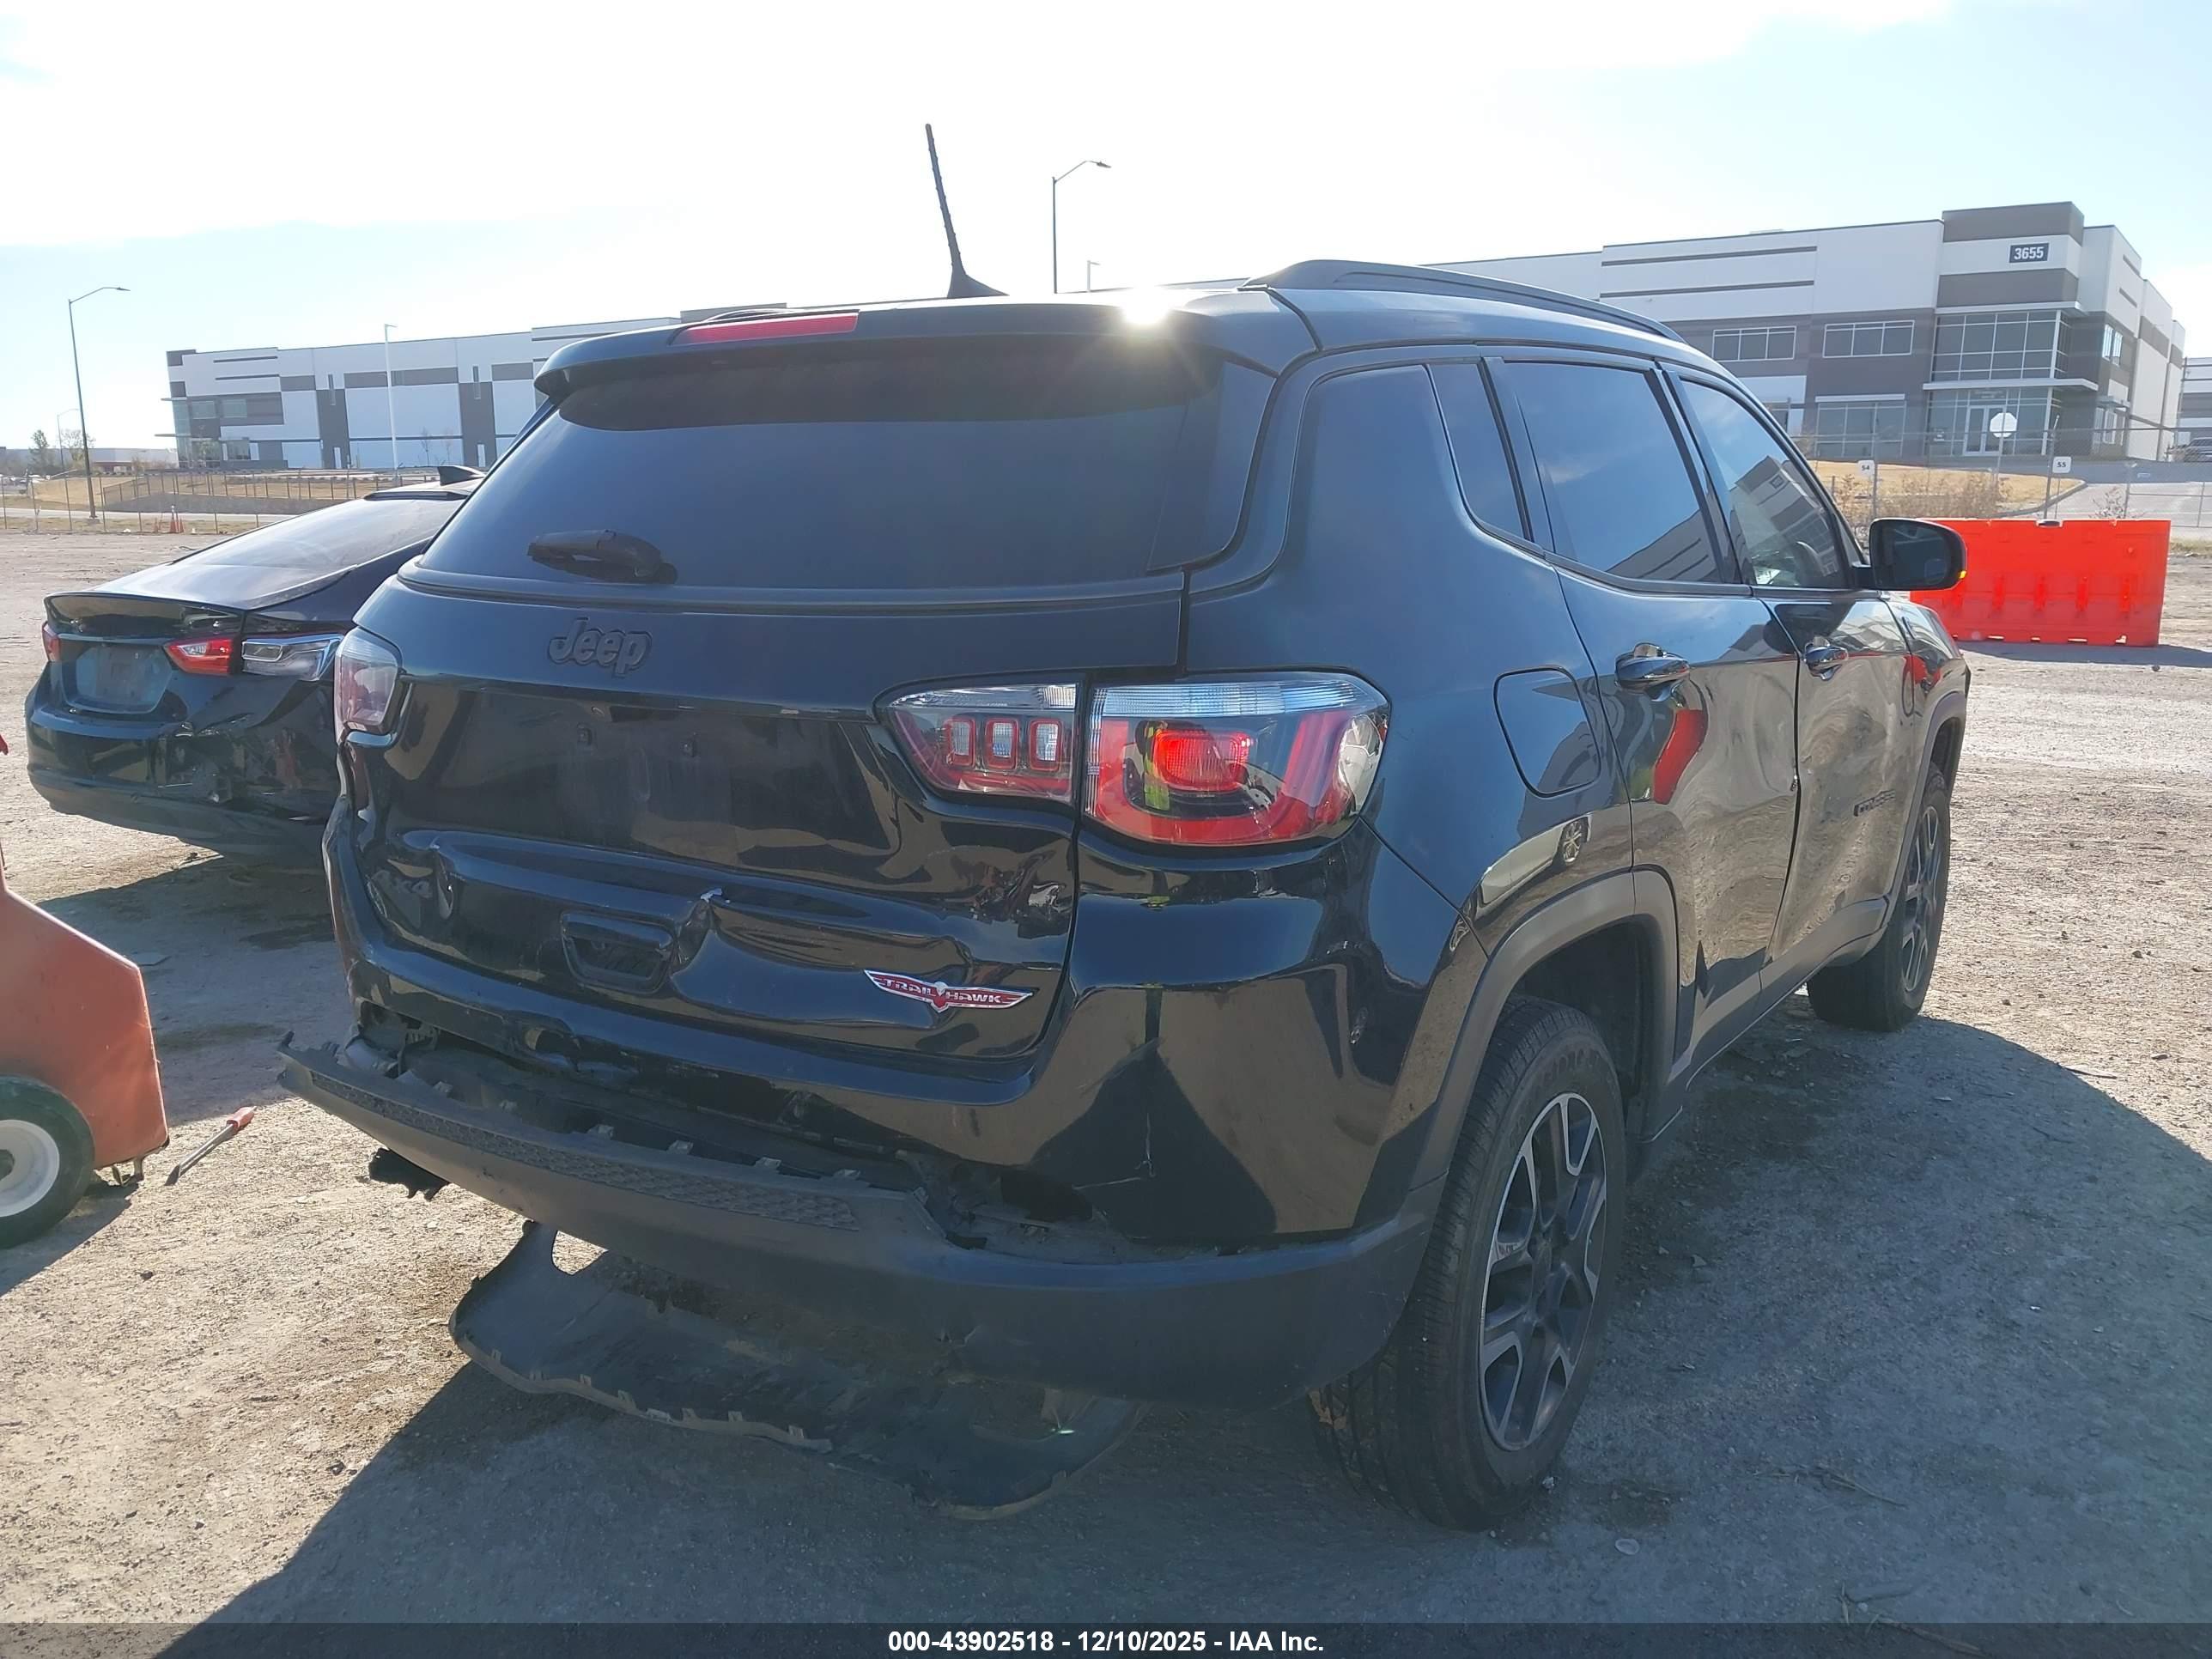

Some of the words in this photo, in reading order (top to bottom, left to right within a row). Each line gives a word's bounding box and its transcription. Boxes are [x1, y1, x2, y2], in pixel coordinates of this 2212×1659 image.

[2014, 246, 2045, 260] 3655
[548, 617, 653, 678] Jeep
[945, 990, 1003, 1004] HAWK
